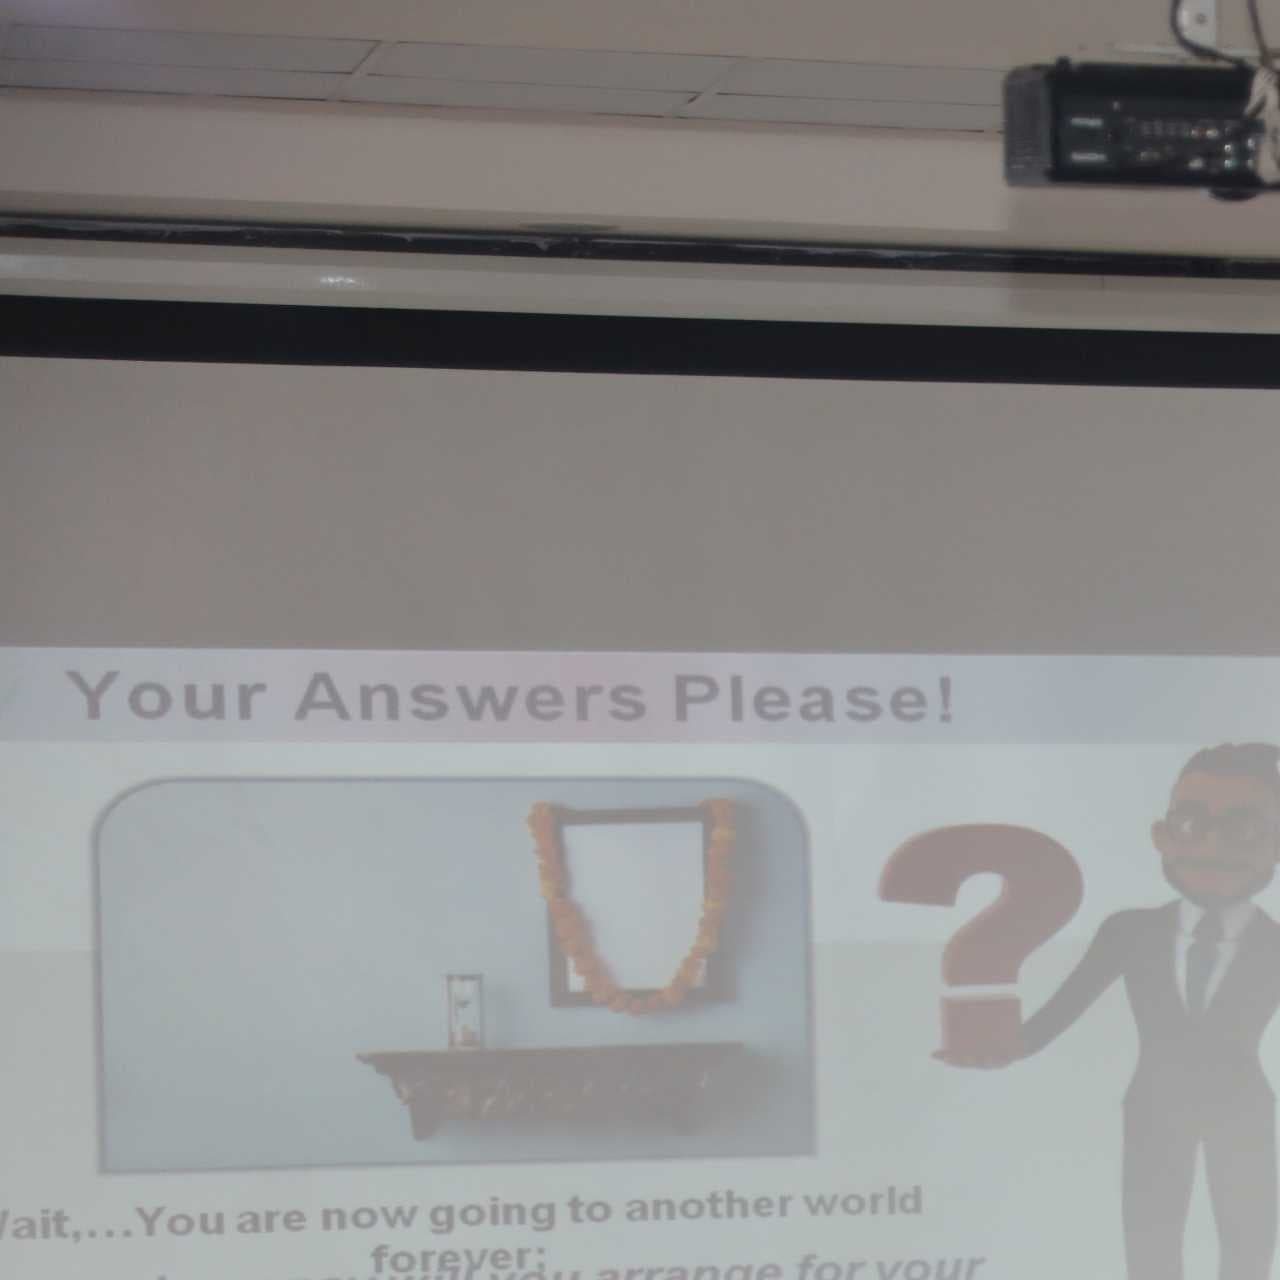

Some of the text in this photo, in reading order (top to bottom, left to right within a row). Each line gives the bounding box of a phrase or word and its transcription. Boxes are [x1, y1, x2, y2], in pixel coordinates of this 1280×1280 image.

[64, 668, 953, 725] Your Answers Please!
[235, 1208, 307, 1235] are
[321, 1204, 418, 1232] now
[429, 1196, 557, 1235] going
[567, 1194, 613, 1224] to
[624, 1189, 794, 1223] another
[803, 1184, 924, 1217] world
